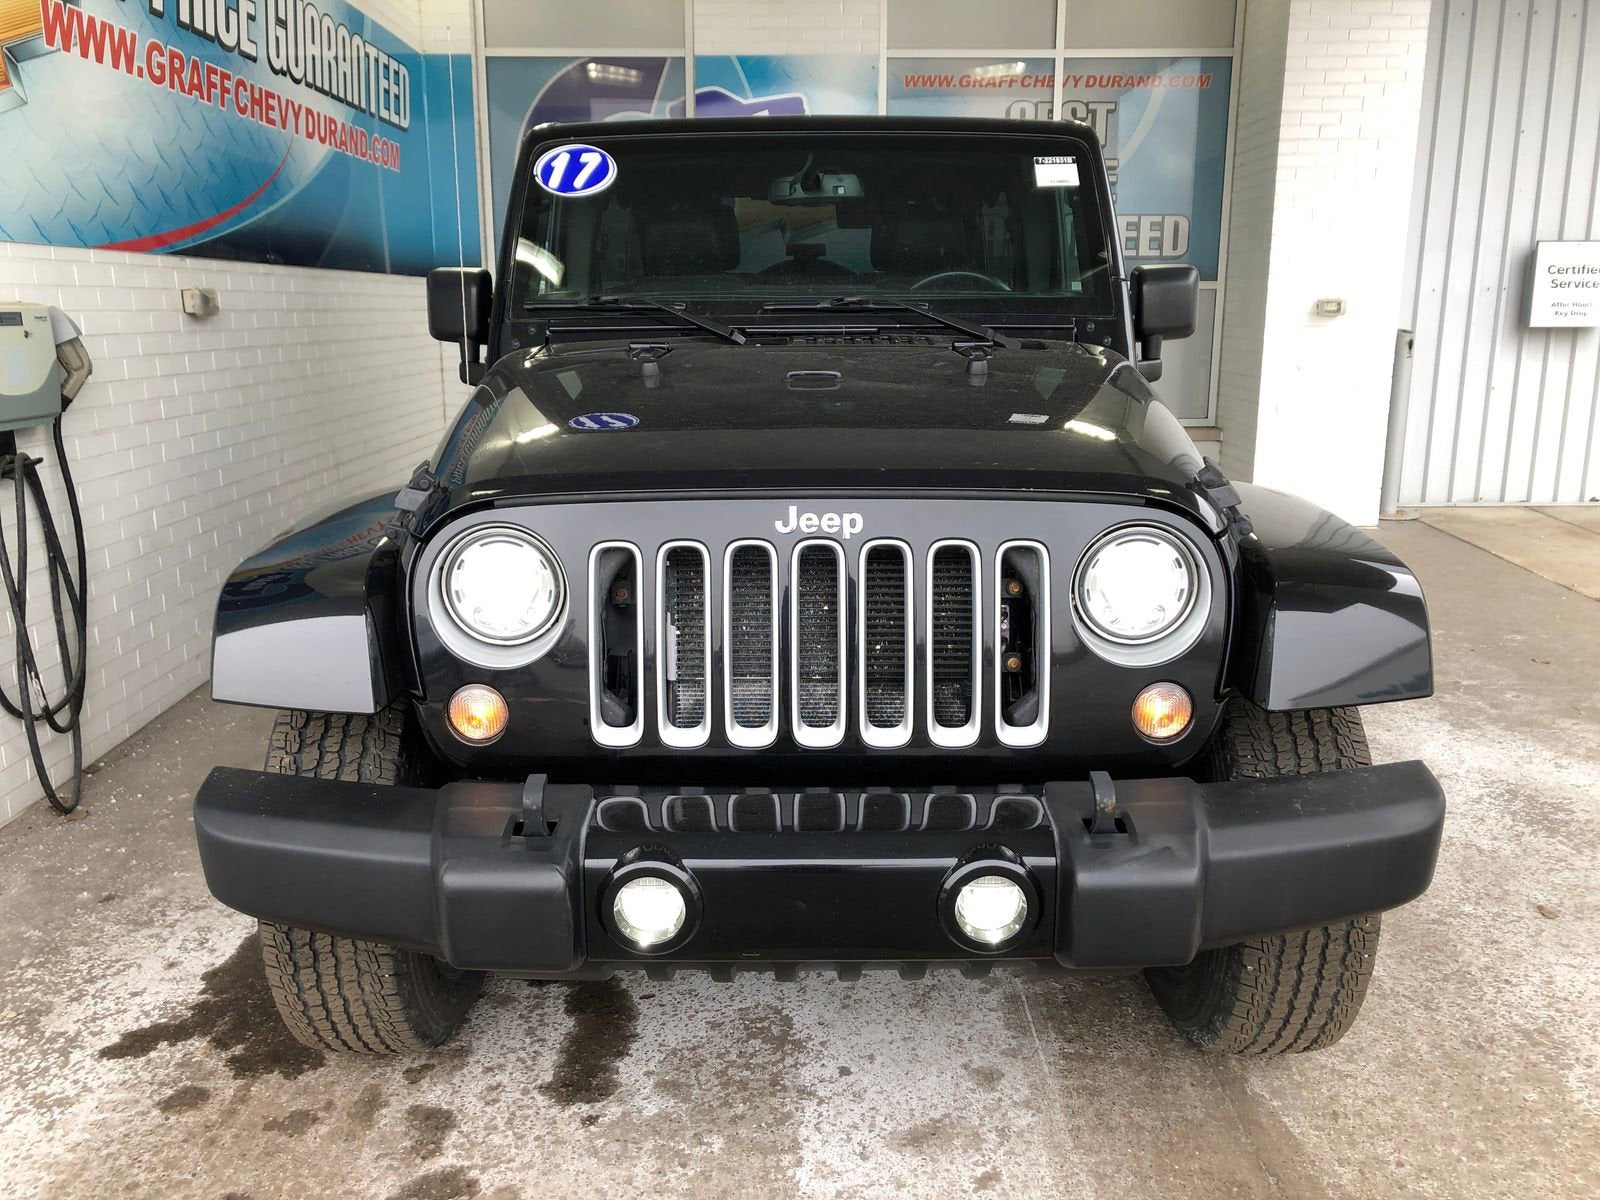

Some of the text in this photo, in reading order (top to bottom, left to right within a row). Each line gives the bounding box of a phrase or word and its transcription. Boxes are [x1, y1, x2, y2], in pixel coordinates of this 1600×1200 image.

[265, 0, 411, 132] GUARANTEED
[40, 0, 401, 172] WWW.GRAFFCHEVYDURAND.COM
[548, 151, 603, 189] 17
[1550, 278, 1600, 289] Service
[774, 505, 864, 539] Jeep
